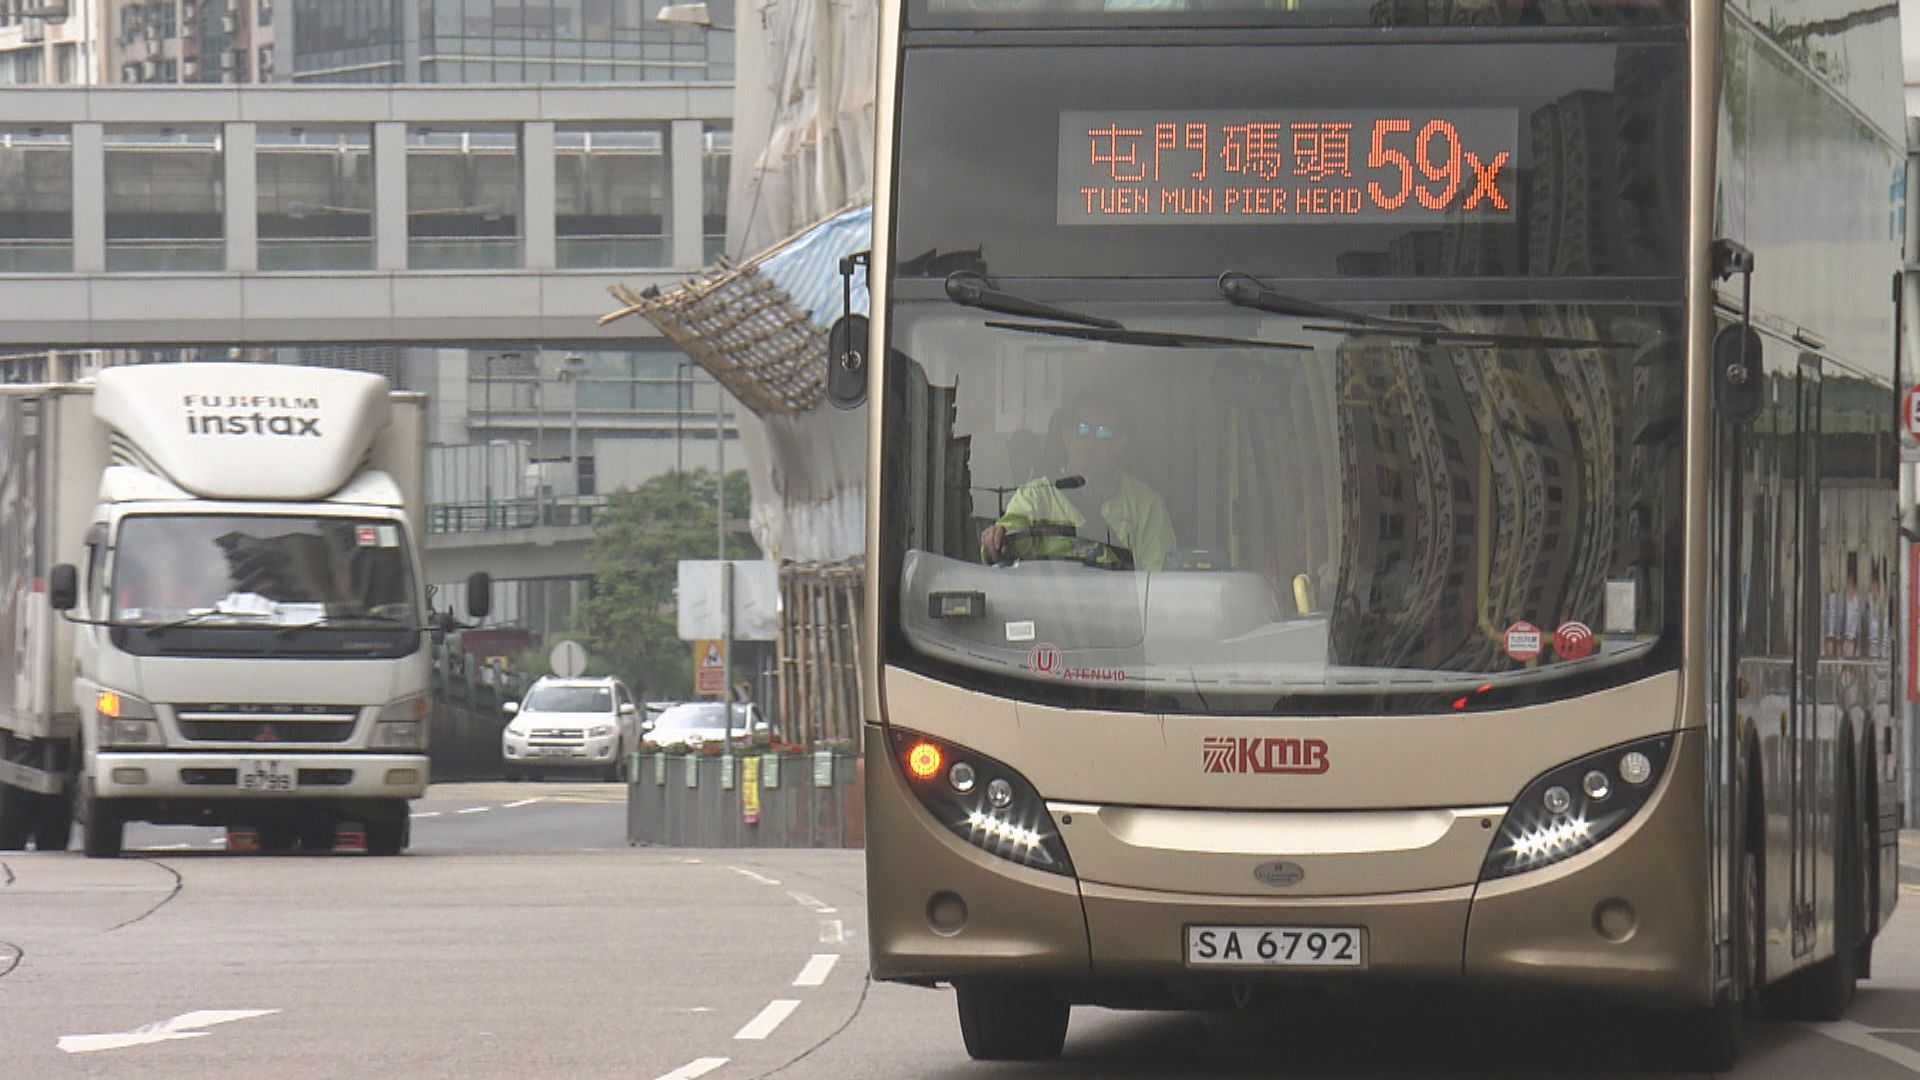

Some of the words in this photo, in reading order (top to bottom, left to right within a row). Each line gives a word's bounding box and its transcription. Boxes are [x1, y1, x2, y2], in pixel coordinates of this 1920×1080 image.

[1088, 122, 1353, 182] 屯門碼頭
[1080, 187, 1149, 214] TUEN
[1160, 187, 1213, 214] MUN
[1224, 187, 1288, 214] PIER
[1295, 187, 1362, 214] HEAD
[184, 394, 320, 409] FUJIFILM
[186, 410, 323, 437] instax
[1063, 667, 1126, 681] ATENU10
[1238, 737, 1331, 775] KMB
[1198, 930, 1244, 960] SA
[1256, 931, 1354, 961] 6792
